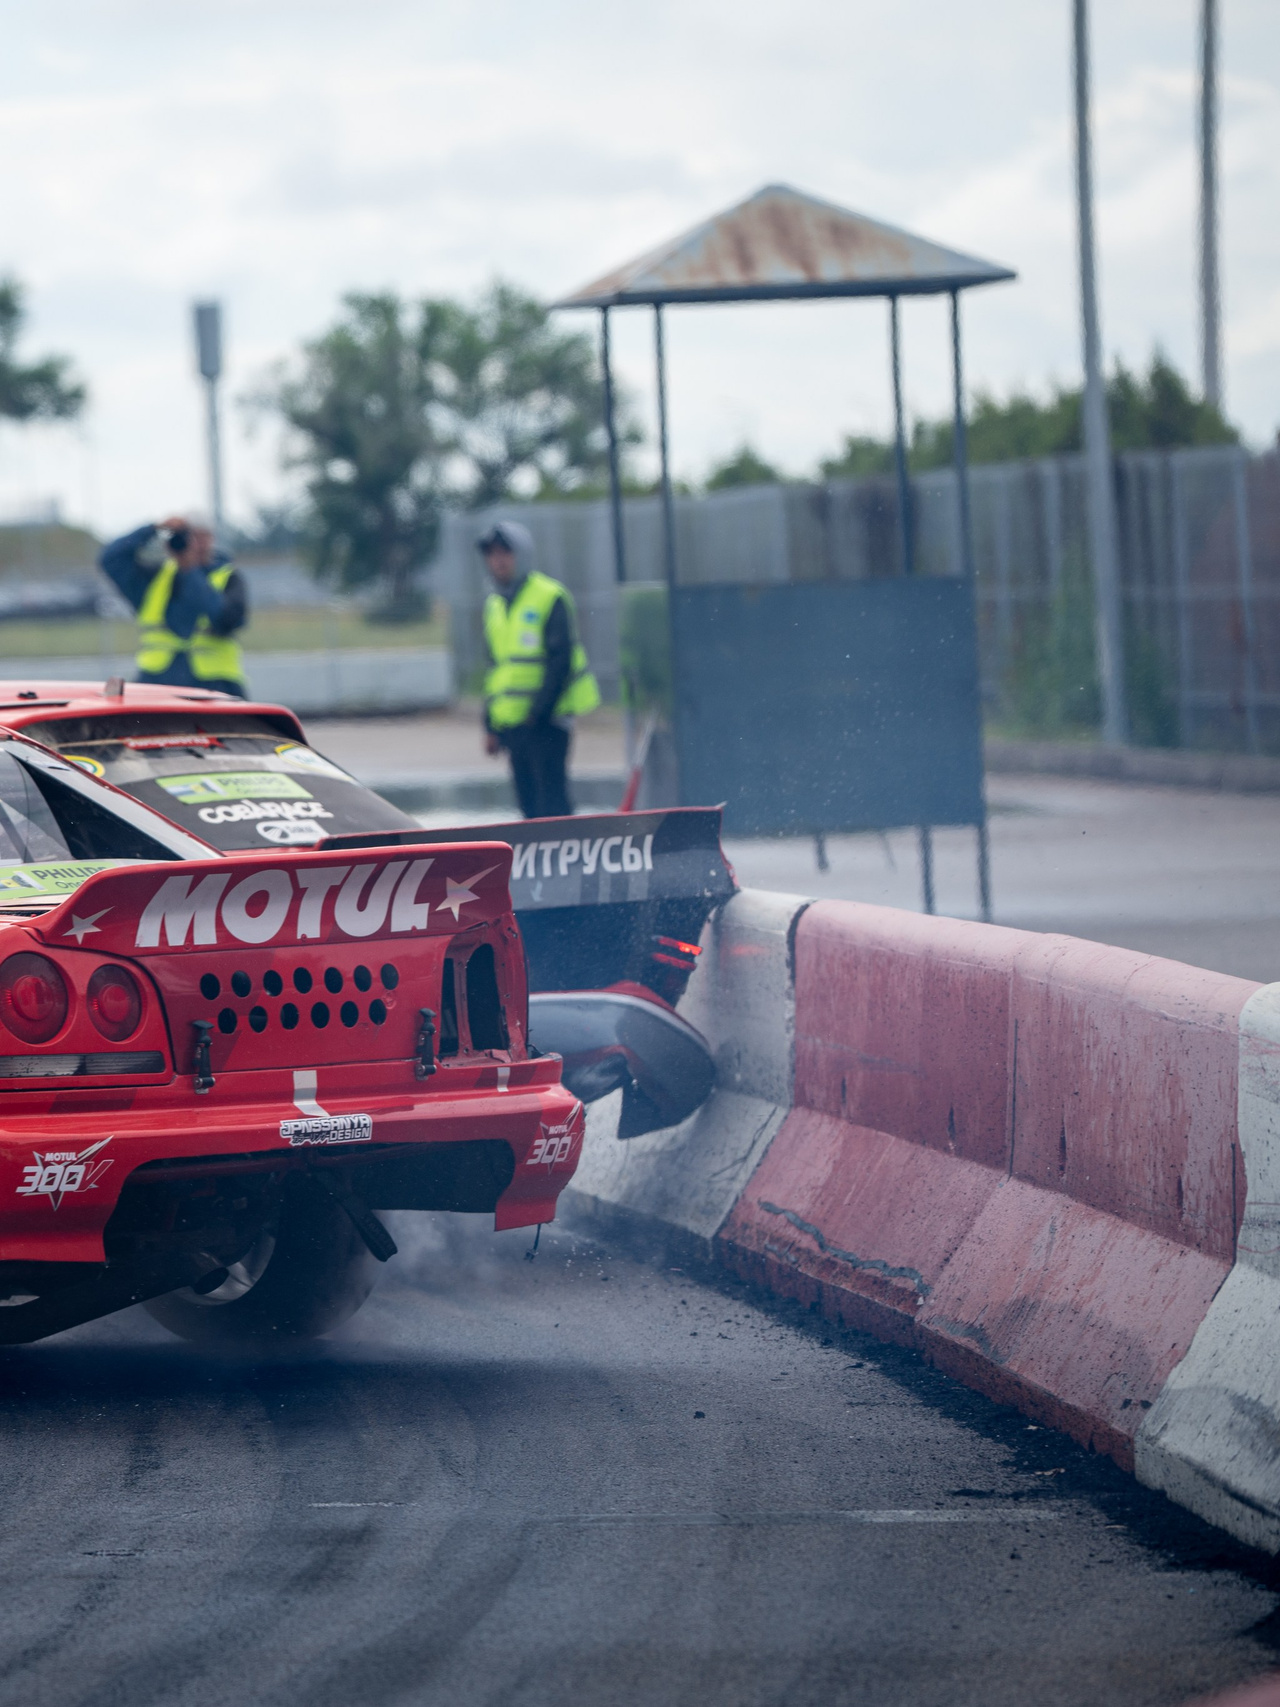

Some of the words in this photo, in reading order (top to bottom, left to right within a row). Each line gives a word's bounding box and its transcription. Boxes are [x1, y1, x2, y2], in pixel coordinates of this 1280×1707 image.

[511, 833, 654, 880] ИТРУСЫ
[134, 858, 435, 948] MOTUL
[329, 1127, 370, 1141] DESIGN
[44, 1152, 77, 1162] MOTUL
[15, 1159, 115, 1193] 300V
